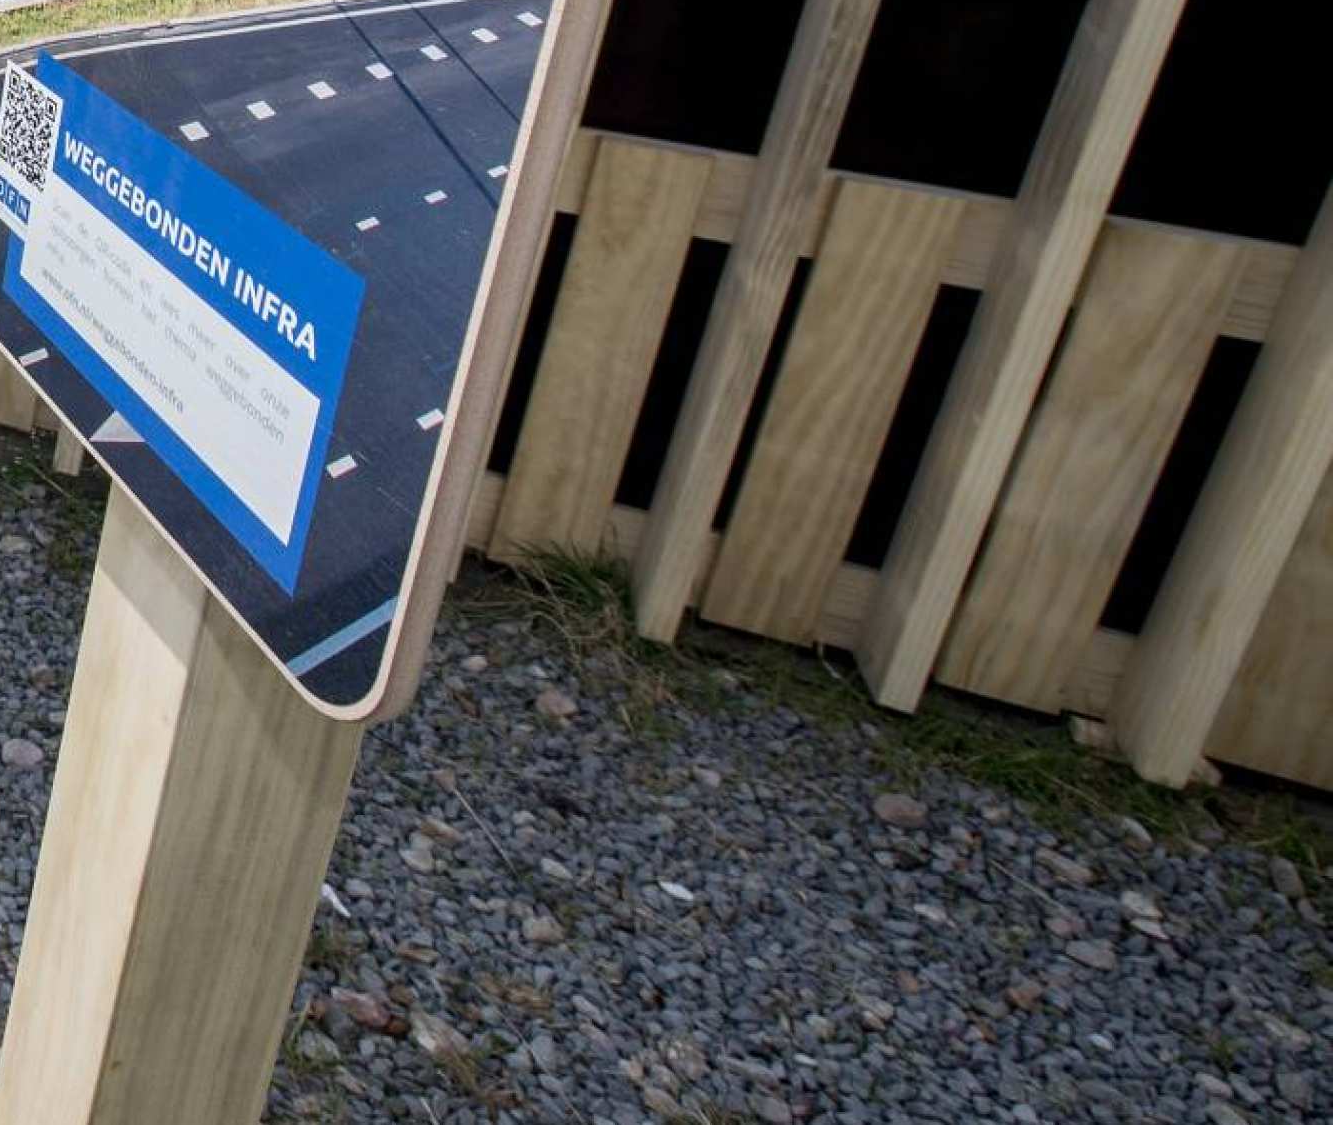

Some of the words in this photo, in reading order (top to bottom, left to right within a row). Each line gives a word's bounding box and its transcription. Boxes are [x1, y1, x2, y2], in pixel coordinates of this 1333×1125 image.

[64, 130, 230, 287] WEGGEBONDEN
[233, 266, 316, 361] INFRA
[261, 386, 289, 418] onze
